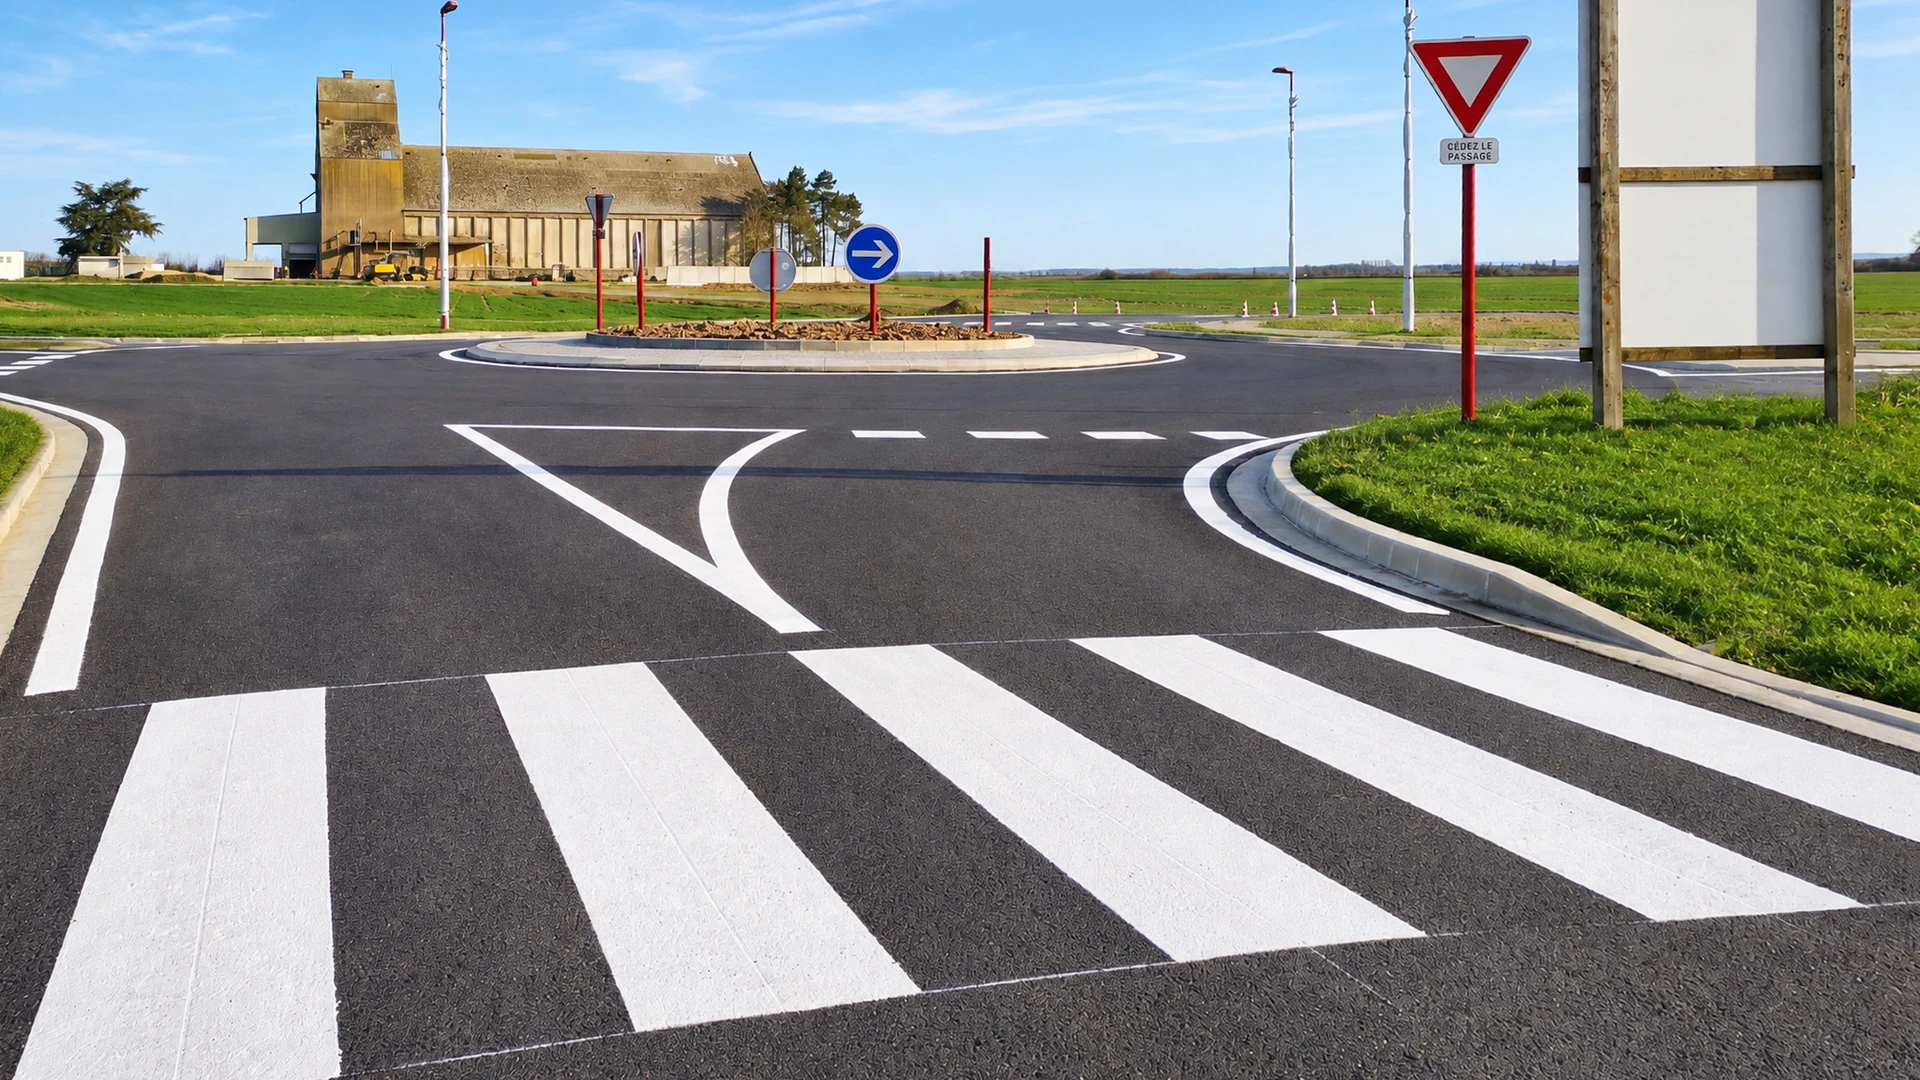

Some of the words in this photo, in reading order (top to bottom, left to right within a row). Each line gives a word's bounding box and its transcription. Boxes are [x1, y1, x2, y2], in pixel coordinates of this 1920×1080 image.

[1447, 141, 1479, 151] CÉDEZ
[1481, 141, 1493, 150] LE
[1447, 152, 1492, 161] PASSAGE
